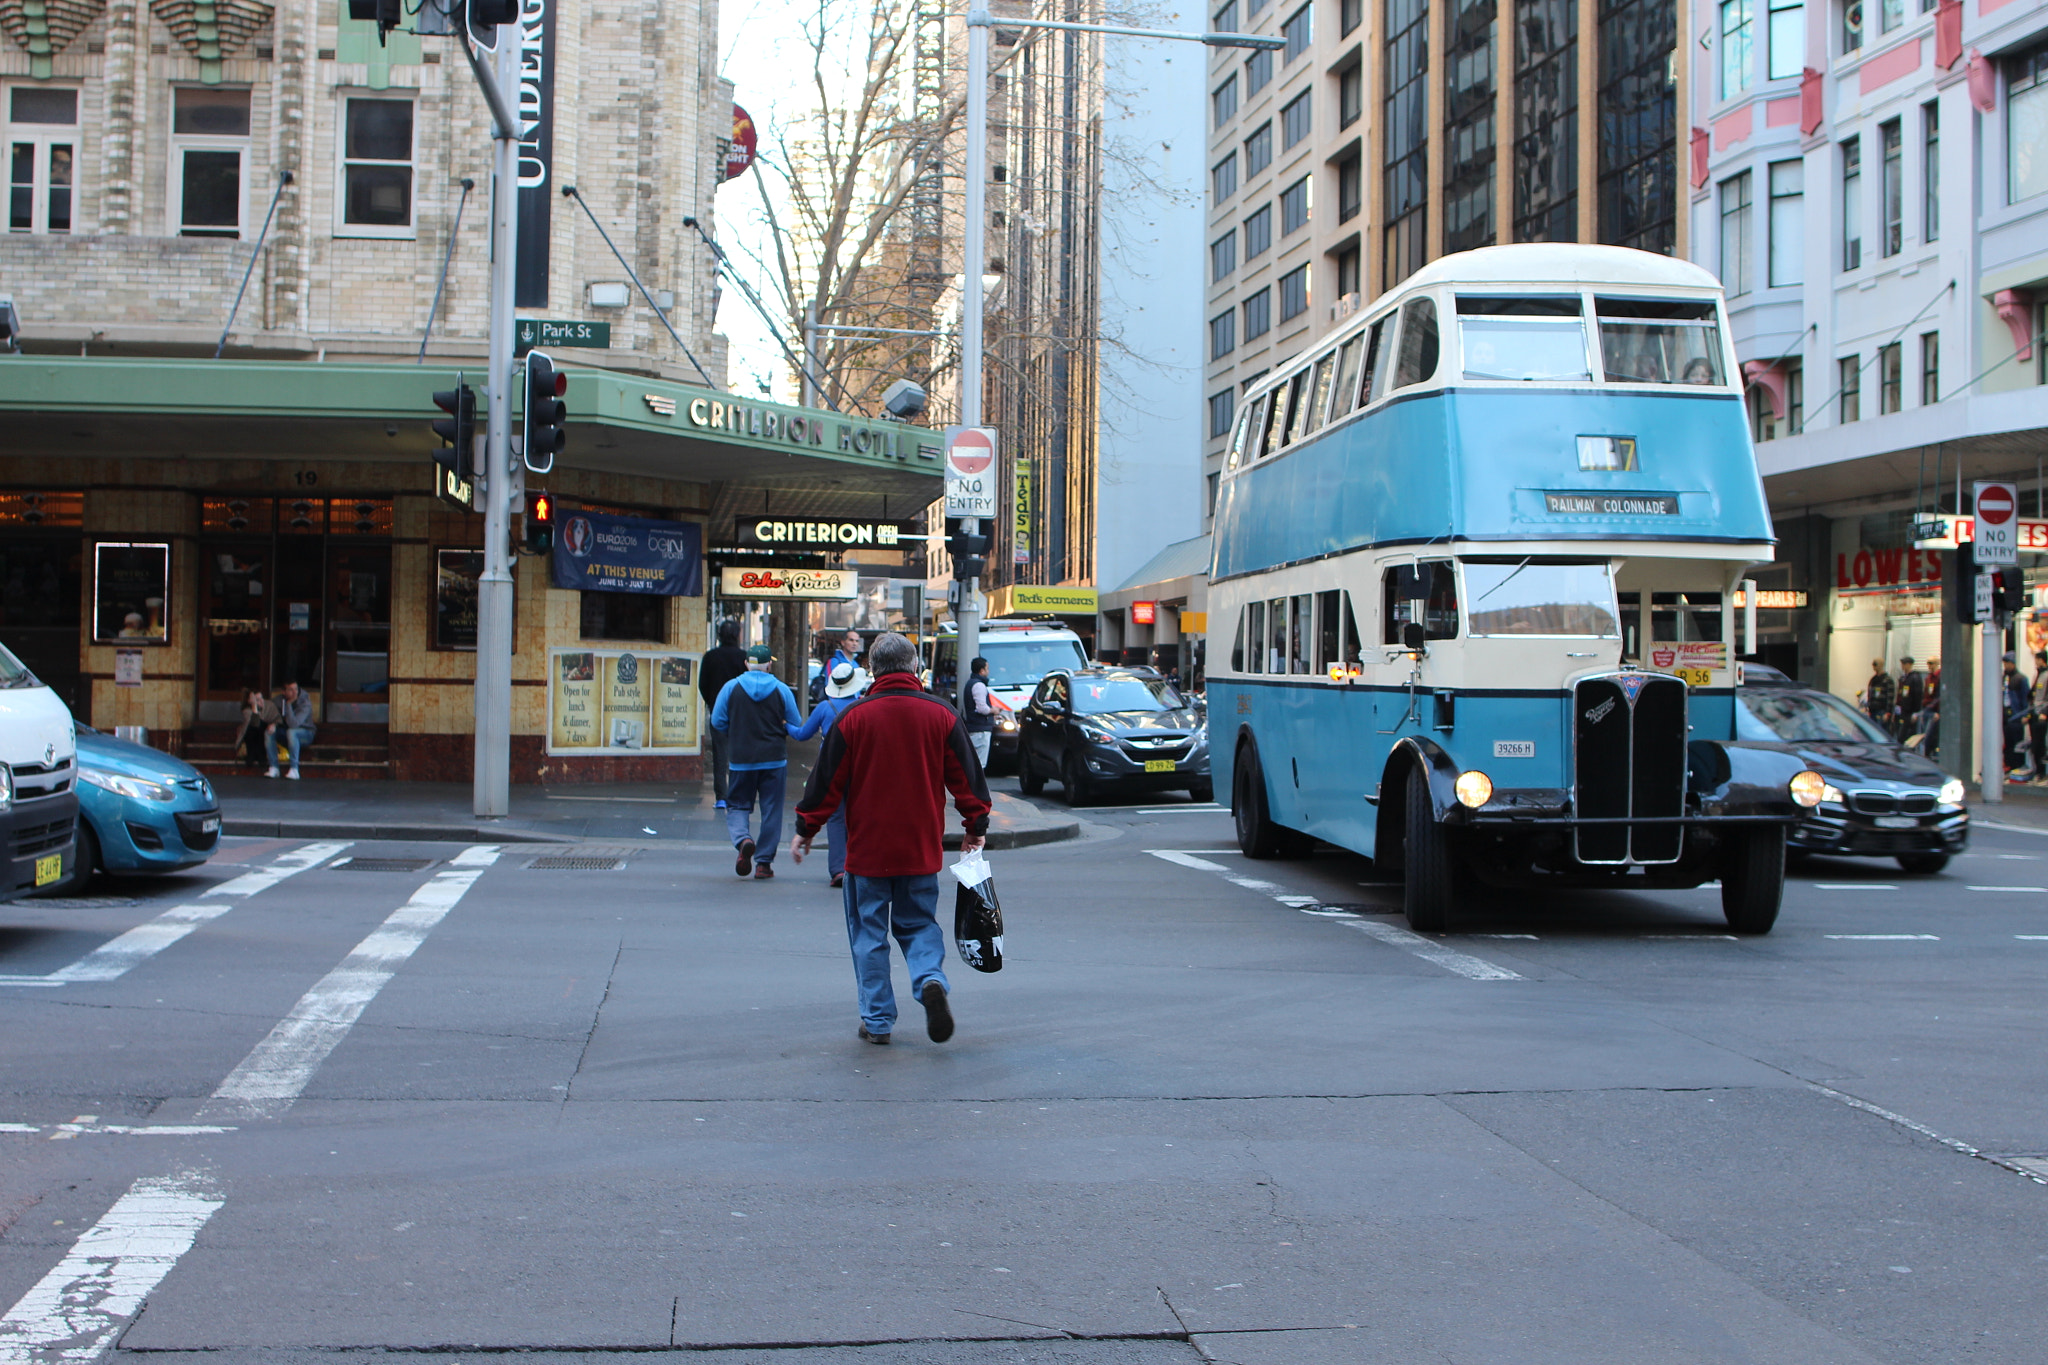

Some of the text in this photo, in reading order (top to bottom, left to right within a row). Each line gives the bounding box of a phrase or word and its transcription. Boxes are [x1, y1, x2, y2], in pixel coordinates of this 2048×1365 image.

[543, 323, 592, 339] Park St
[690, 398, 908, 460] CRITERION HOTEL
[294, 471, 317, 486] 19
[959, 480, 982, 493] NO
[950, 498, 993, 510] ENTRY
[1551, 498, 1667, 514] RAILWAY COLONNADE
[755, 521, 873, 544] CRITERION
[1958, 521, 2048, 547] LES
[1986, 530, 2006, 542] NO
[607, 545, 628, 553] FRANCE
[1979, 547, 2014, 558] ENTRY
[587, 564, 665, 580] AT THIS VENUE
[1838, 547, 1942, 588] LOWES
[598, 578, 616, 587] JUNE
[628, 580, 645, 588] JULY
[740, 572, 840, 590] Echo Point
[1978, 578, 1991, 589] ONE
[1017, 593, 1094, 606] Ted's cameras
[1756, 591, 1795, 605] PEARLS
[1978, 593, 1991, 602] WAY
[1678, 644, 1706, 653] FREE
[1695, 671, 1709, 683] 56
[564, 684, 591, 697] Open for
[613, 686, 641, 699] Pub style
[667, 687, 682, 698] Book
[568, 700, 586, 711] lunch
[604, 701, 650, 713] accommodation
[661, 703, 688, 714] your next
[562, 717, 591, 728] & dinner,
[661, 718, 687, 729] function!
[566, 731, 587, 745] 7 days
[1498, 744, 1530, 753] 39266 H
